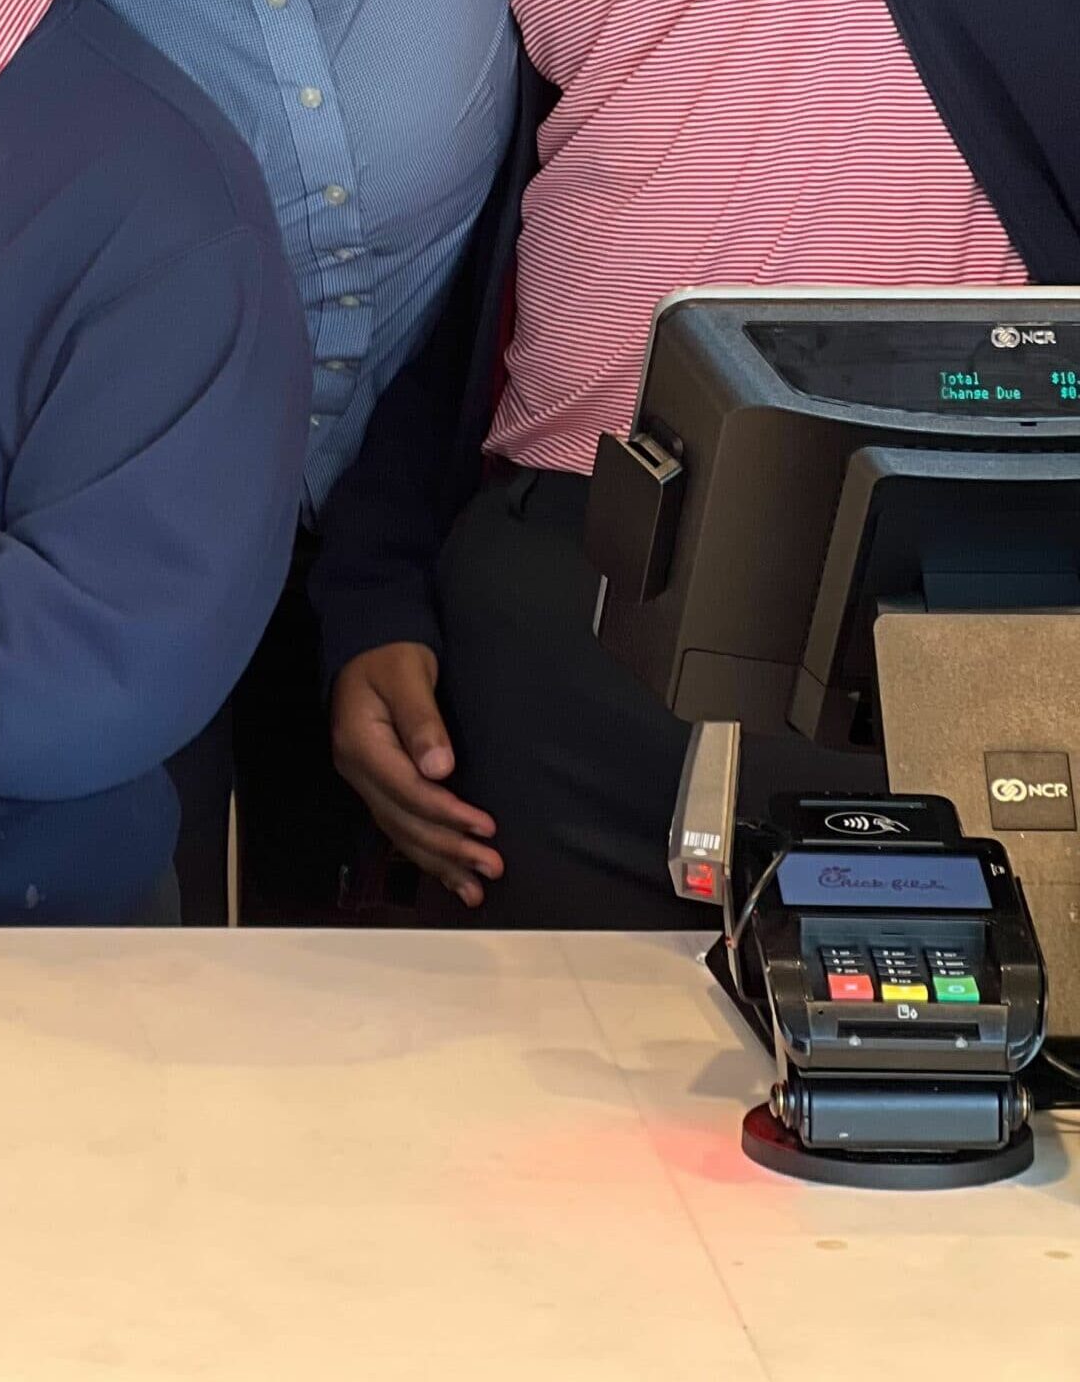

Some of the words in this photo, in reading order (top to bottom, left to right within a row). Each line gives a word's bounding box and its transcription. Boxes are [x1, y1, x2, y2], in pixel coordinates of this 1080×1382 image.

[1021, 330, 1056, 344] NCR
[940, 372, 979, 385] Total
[997, 386, 1022, 400] Due
[1028, 783, 1069, 797] NCR
